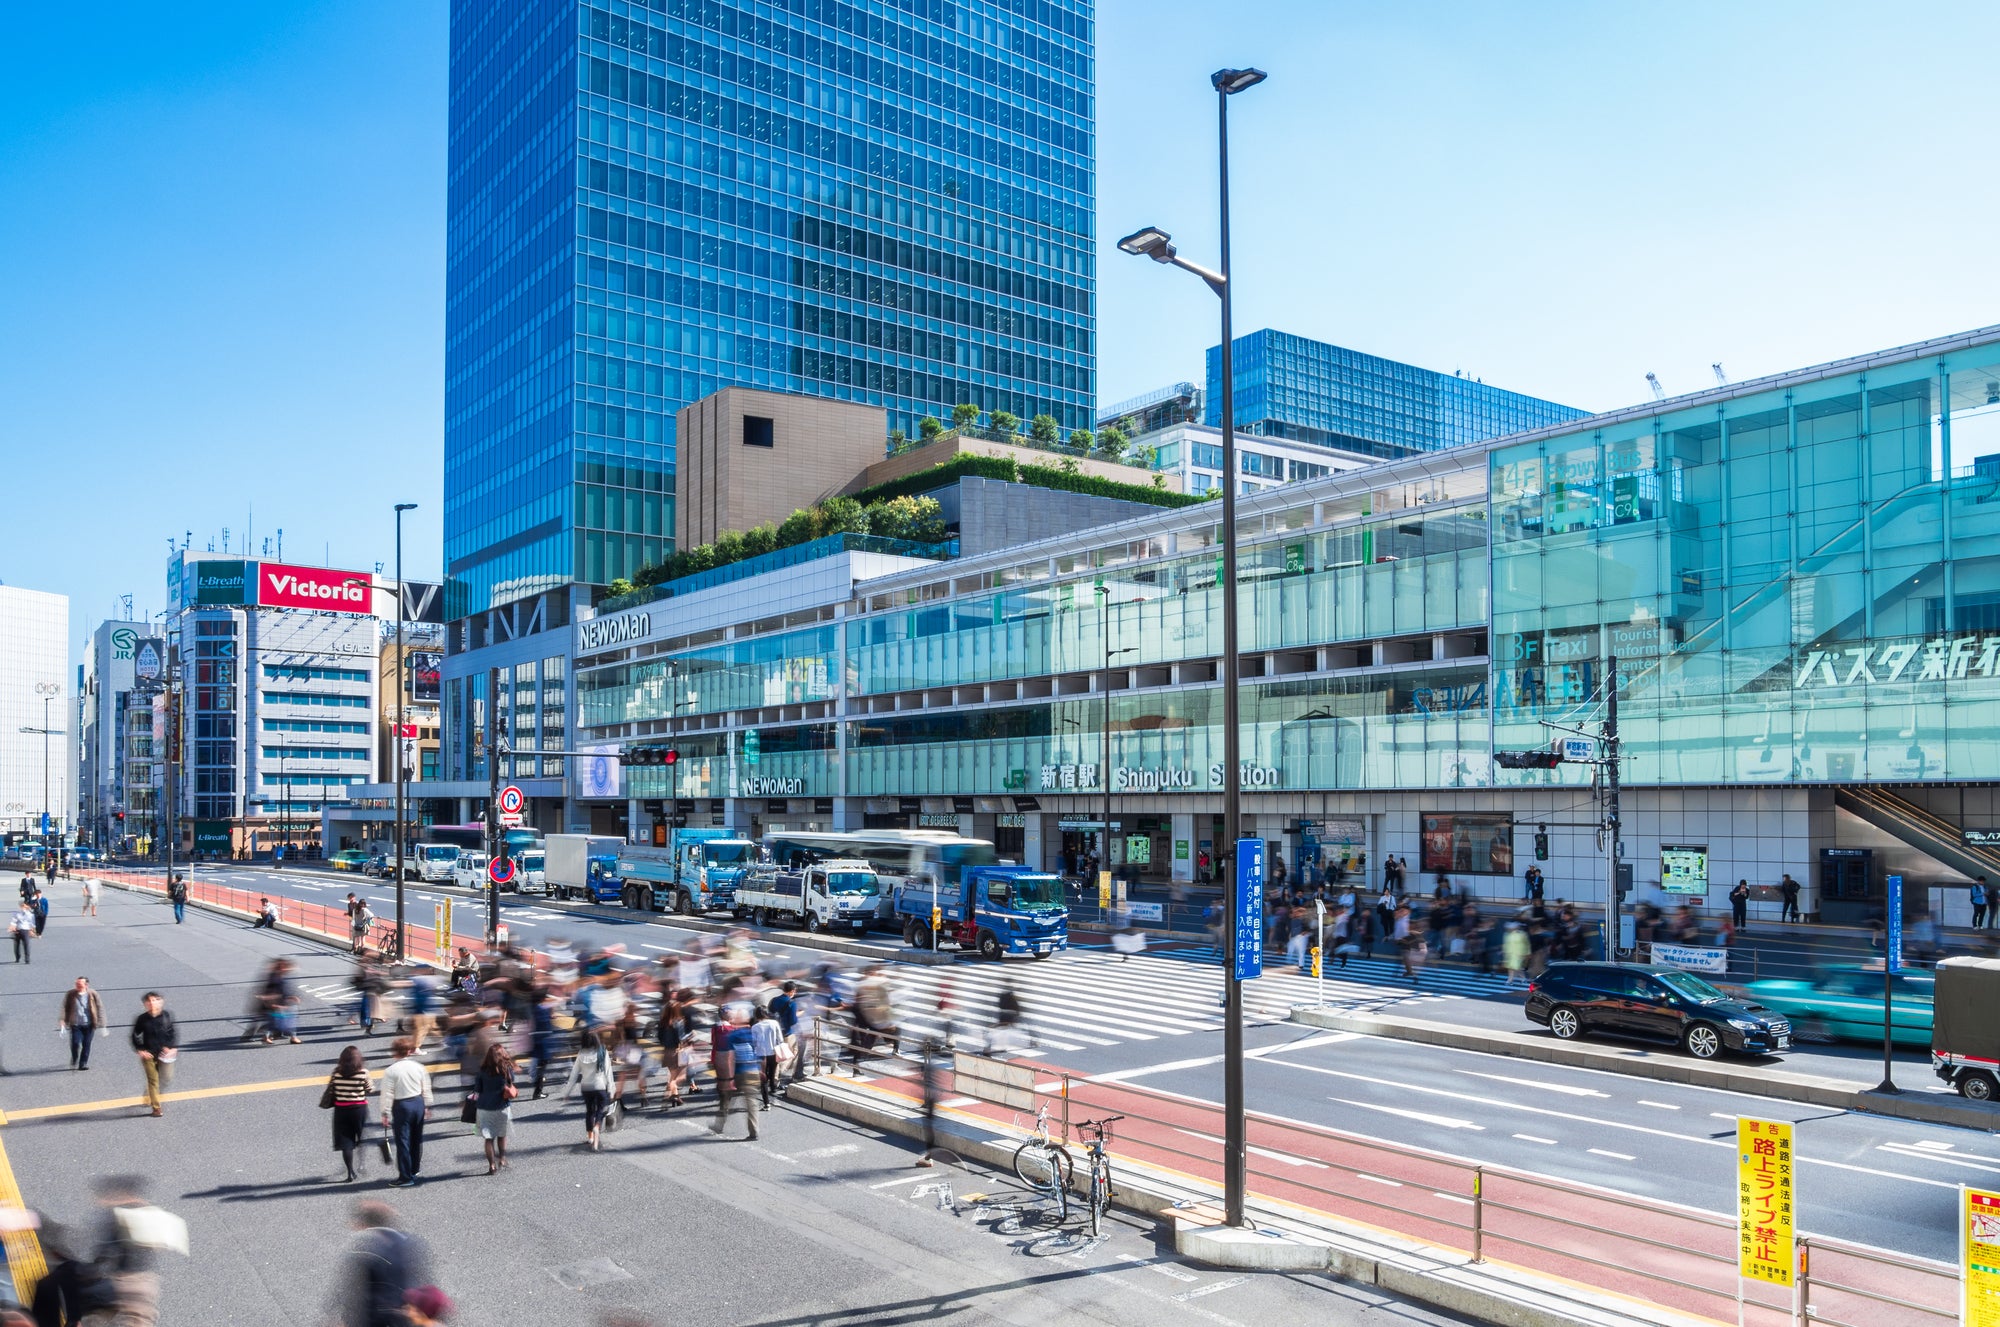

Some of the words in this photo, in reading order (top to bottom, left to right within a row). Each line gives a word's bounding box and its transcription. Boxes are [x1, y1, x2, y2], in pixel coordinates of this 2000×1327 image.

[1505, 462, 1535, 488] 4F
[1607, 450, 1642, 471] Bus
[1614, 503, 1632, 518] C9
[268, 573, 363, 602] Victoria
[1512, 634, 1538, 661] 3F
[1546, 636, 1588, 658] Taxi
[1612, 627, 1659, 642] Tourist
[1613, 640, 1696, 657] Information
[218, 642, 232, 708] Vctoria
[1614, 657, 1659, 672] Center
[1003, 769, 1025, 789] JR
[1041, 763, 1097, 789] 新宿駅
[1117, 765, 1192, 792] Shinjuku
[1209, 763, 1278, 786] Stion
[1245, 867, 1253, 951] バスタ新宿へは
[1237, 916, 1246, 975] 入れません
[1749, 1121, 1779, 1135] 警告
[1779, 1138, 1791, 1226] 道路交通法違反
[1753, 1137, 1778, 1263] 路上ライブ禁止
[1740, 1182, 1752, 1256] 取締り実施中
